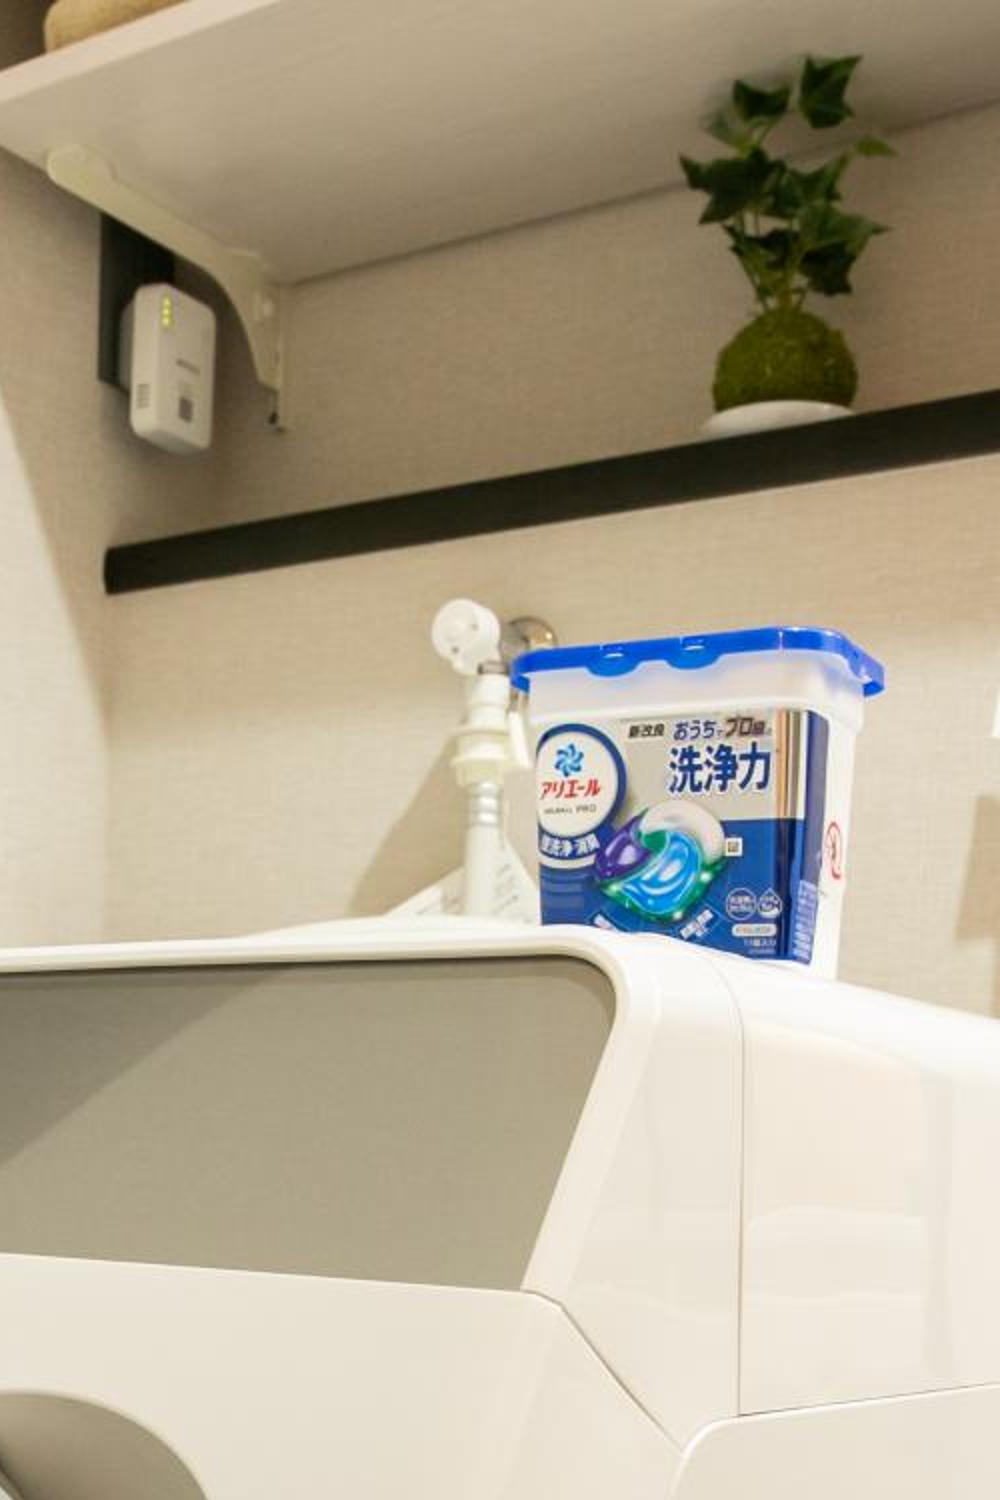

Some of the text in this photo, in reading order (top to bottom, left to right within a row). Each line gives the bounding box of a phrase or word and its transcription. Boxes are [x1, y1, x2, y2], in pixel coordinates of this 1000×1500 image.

[670, 741, 771, 793] 洗浄力
[540, 778, 601, 800] アリエール
